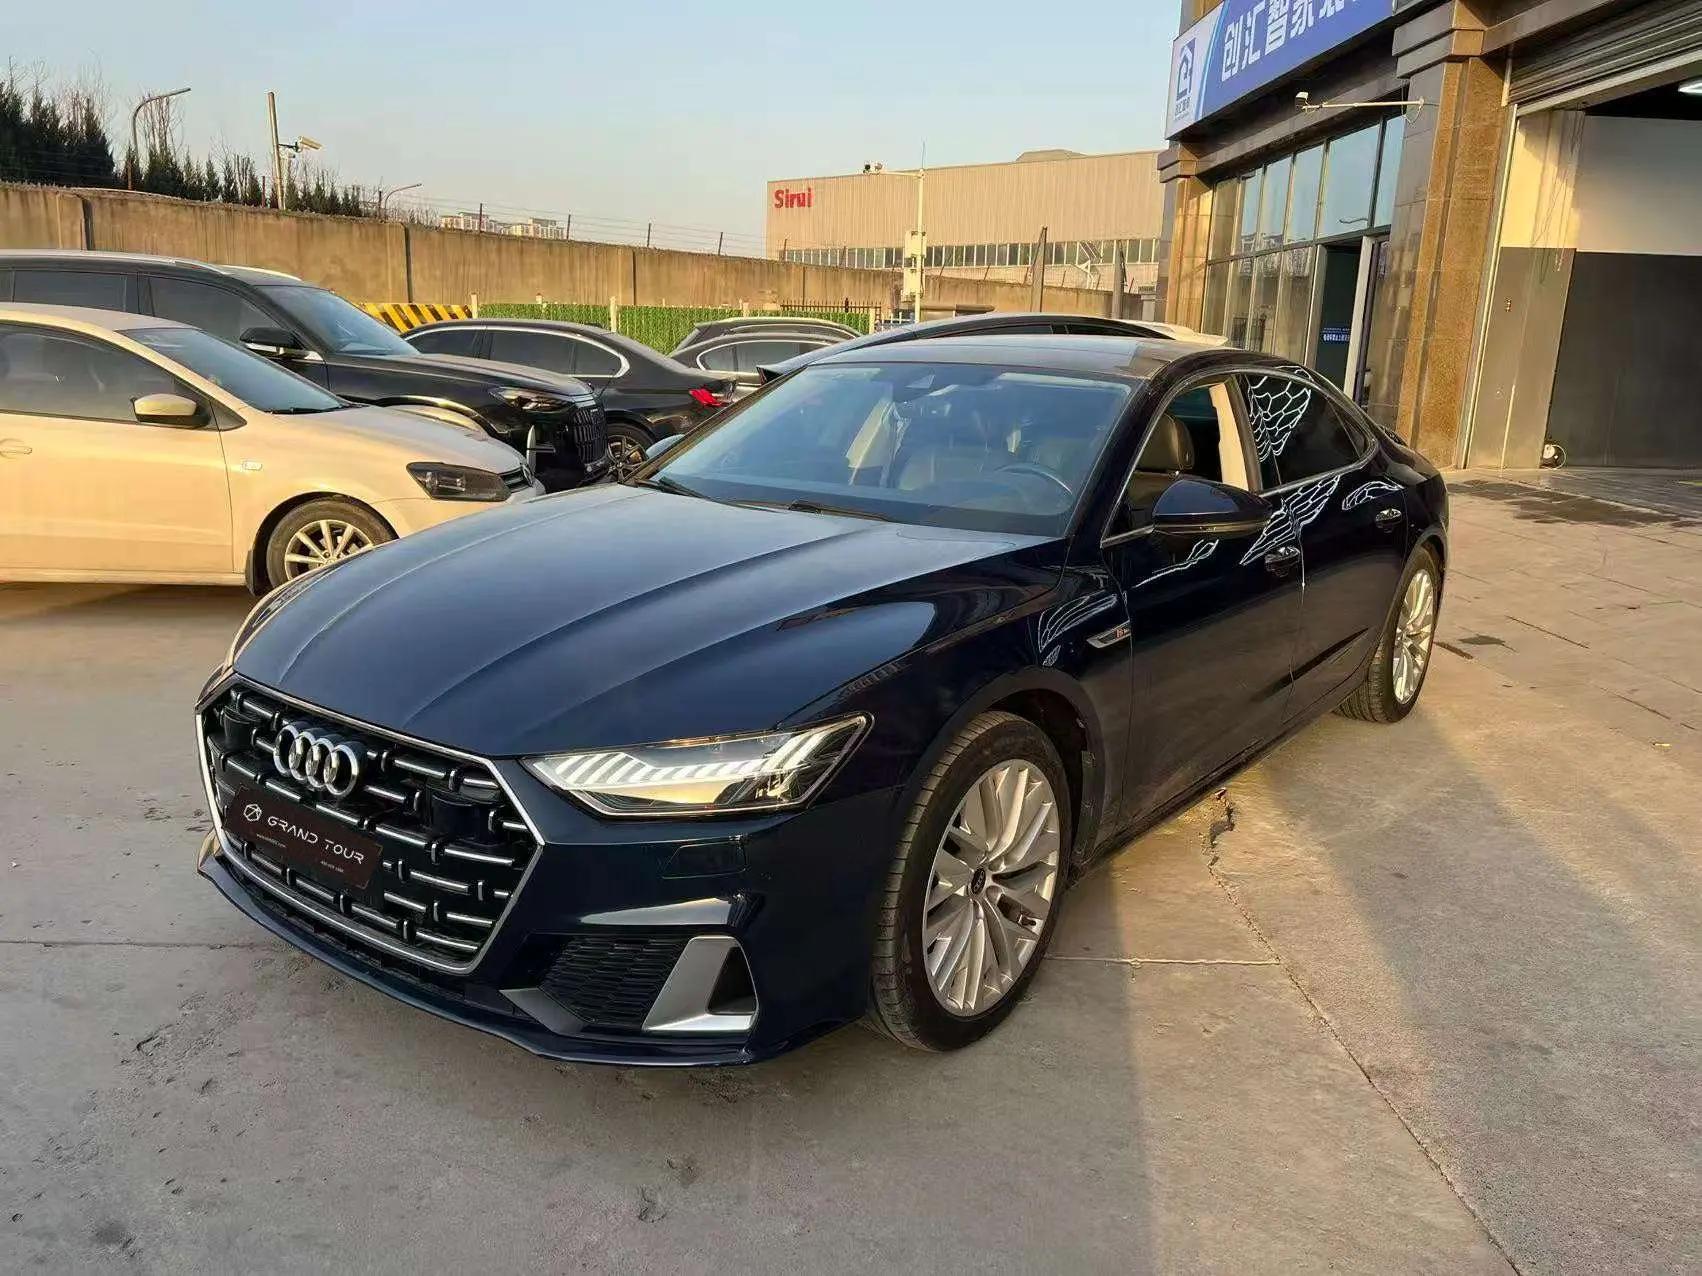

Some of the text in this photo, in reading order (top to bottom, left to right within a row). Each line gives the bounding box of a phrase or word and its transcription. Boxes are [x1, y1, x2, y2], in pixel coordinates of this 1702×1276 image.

[1221, 0, 1357, 82] 创汇智家
[774, 187, 812, 208] Sirui
[267, 815, 319, 844] GRAND
[324, 839, 365, 865] TOUR
